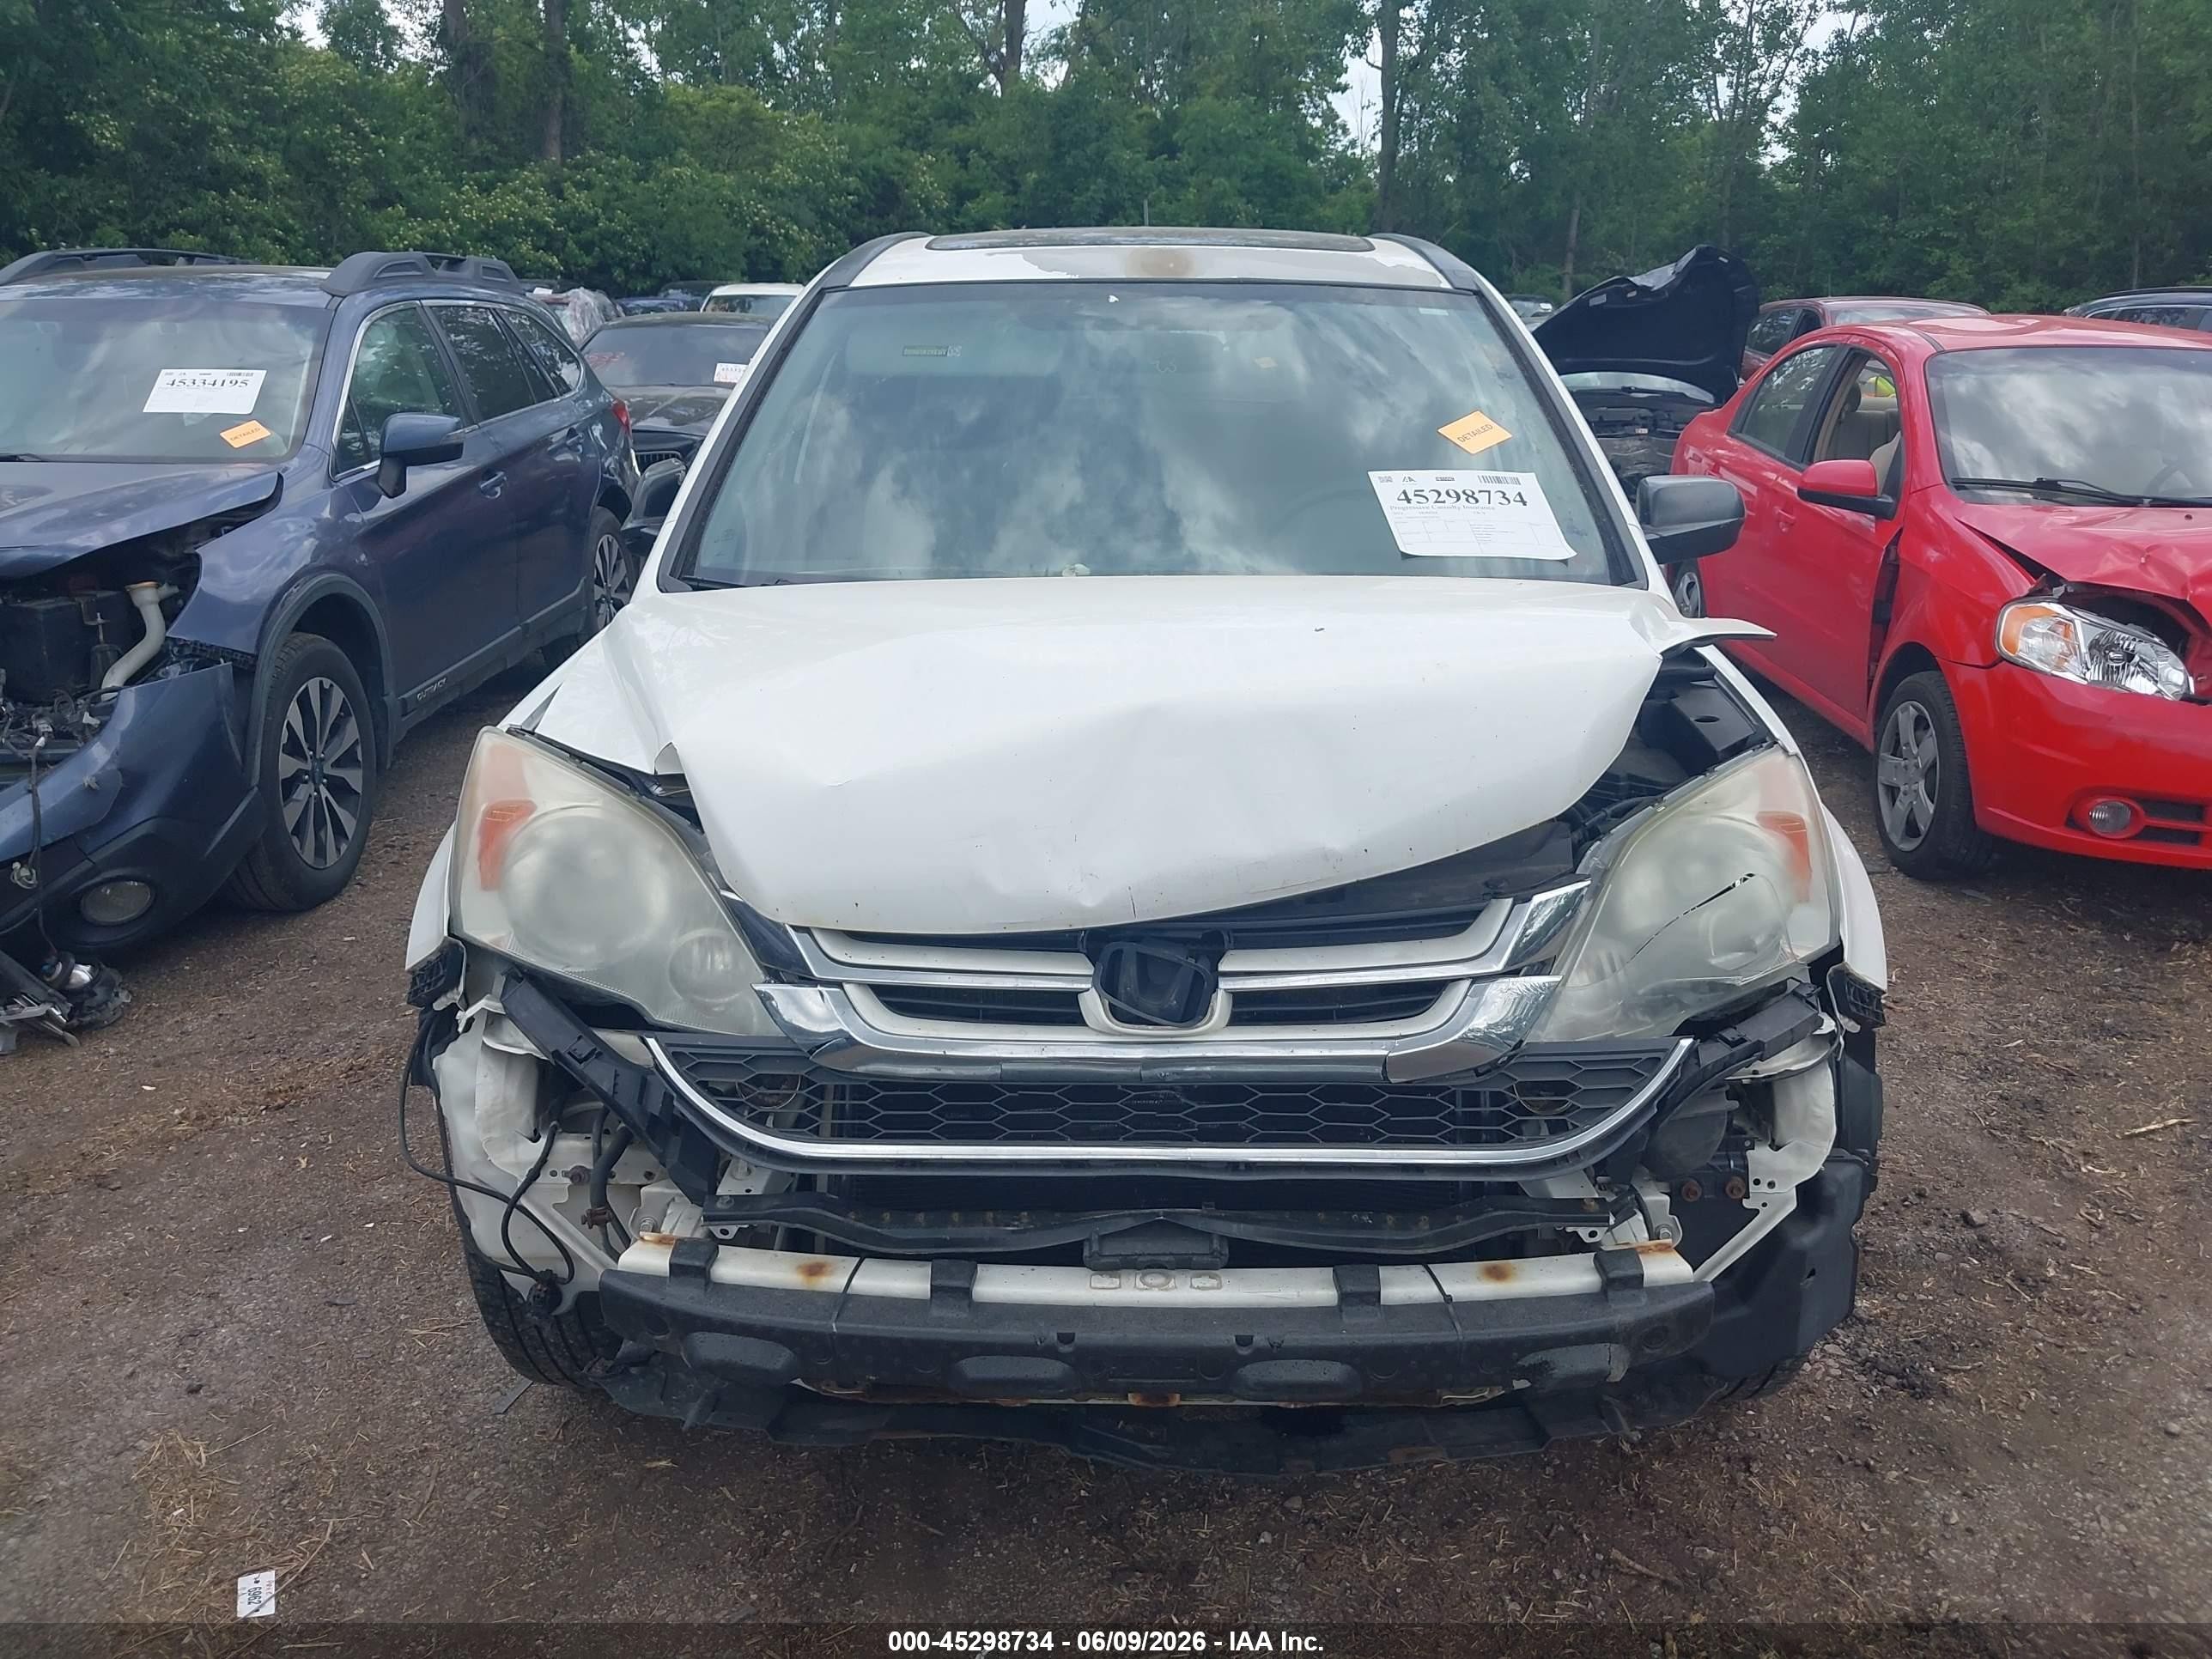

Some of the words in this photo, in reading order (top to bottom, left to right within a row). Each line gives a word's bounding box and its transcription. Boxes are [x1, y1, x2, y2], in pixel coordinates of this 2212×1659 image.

[166, 379, 250, 388] 45334195
[229, 428, 261, 441] DETAILED
[1456, 423, 1493, 443] DETAILED
[1396, 489, 1528, 507] 45298734
[247, 1586, 262, 1605] 6962
